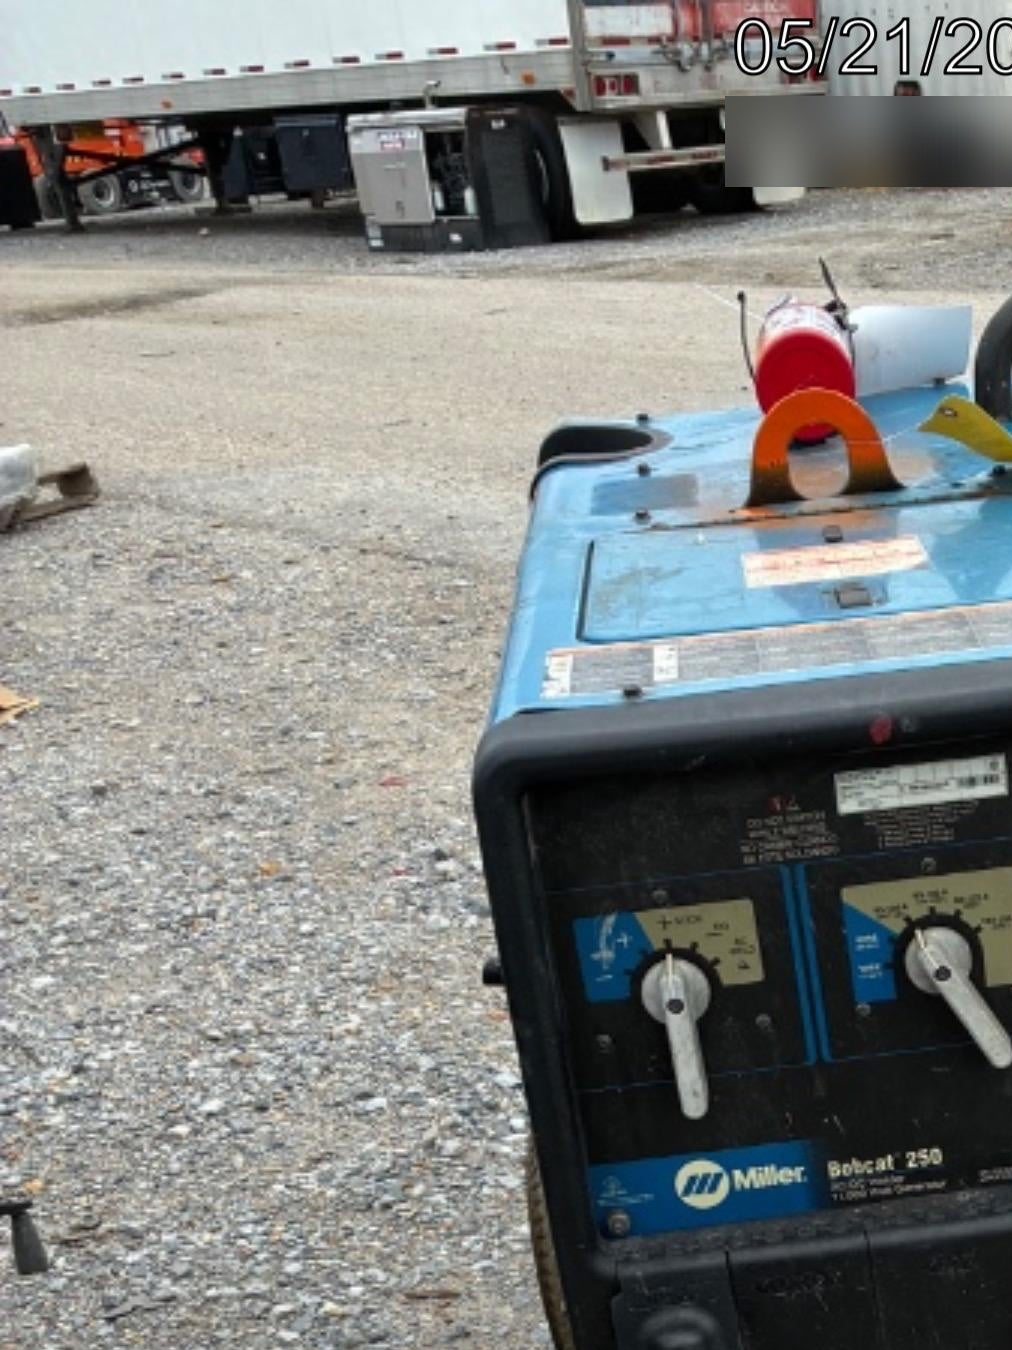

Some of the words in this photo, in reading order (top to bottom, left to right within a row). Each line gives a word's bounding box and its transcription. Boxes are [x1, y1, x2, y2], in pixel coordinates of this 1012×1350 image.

[732, 1164, 804, 1191] Miller
[826, 1154, 896, 1180] Bobcat
[904, 1147, 944, 1169] 250
